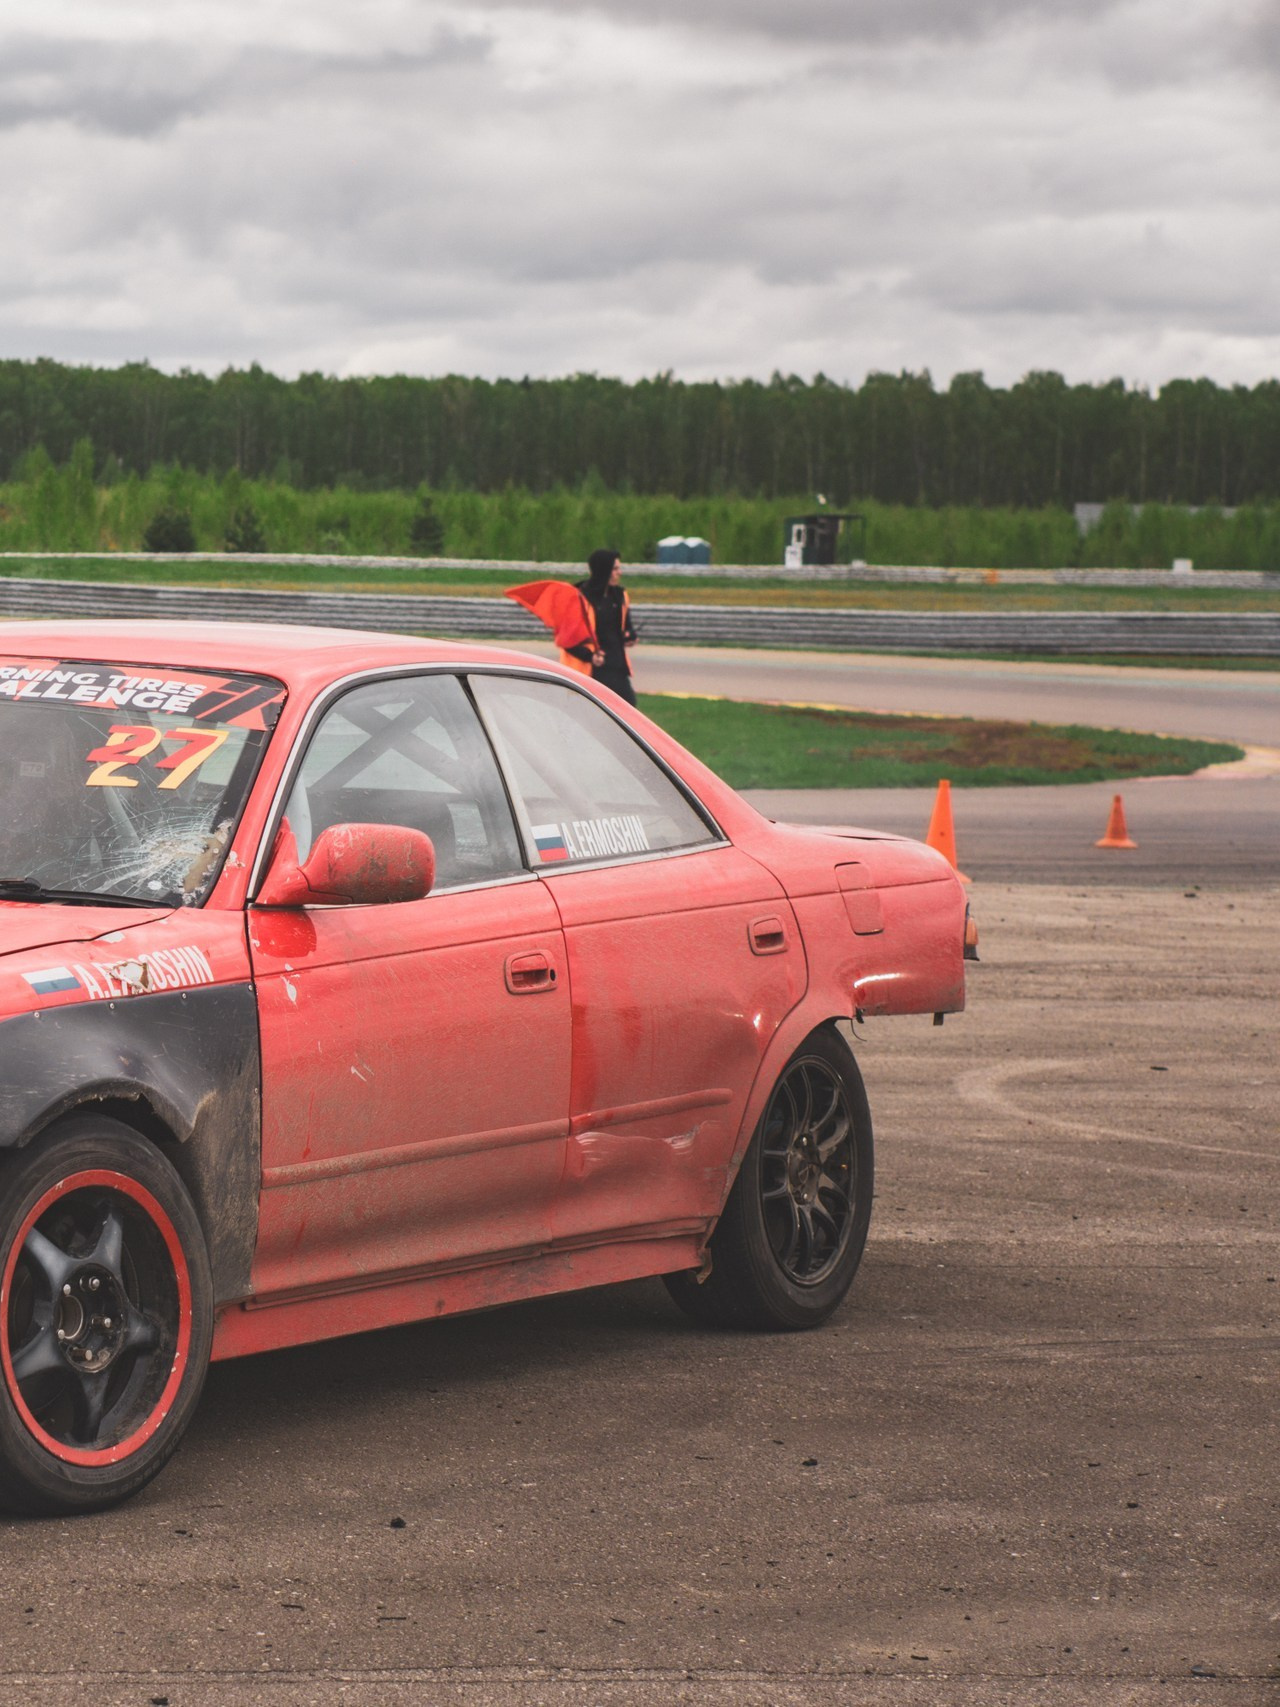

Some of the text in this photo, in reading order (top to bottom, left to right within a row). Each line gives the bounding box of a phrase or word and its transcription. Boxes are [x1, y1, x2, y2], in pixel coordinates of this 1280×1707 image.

[109, 674, 207, 697] TIRES
[86, 724, 230, 790] 27
[561, 815, 651, 858] A.ERMOSHIN
[72, 945, 214, 1000] A.EOSHIN
